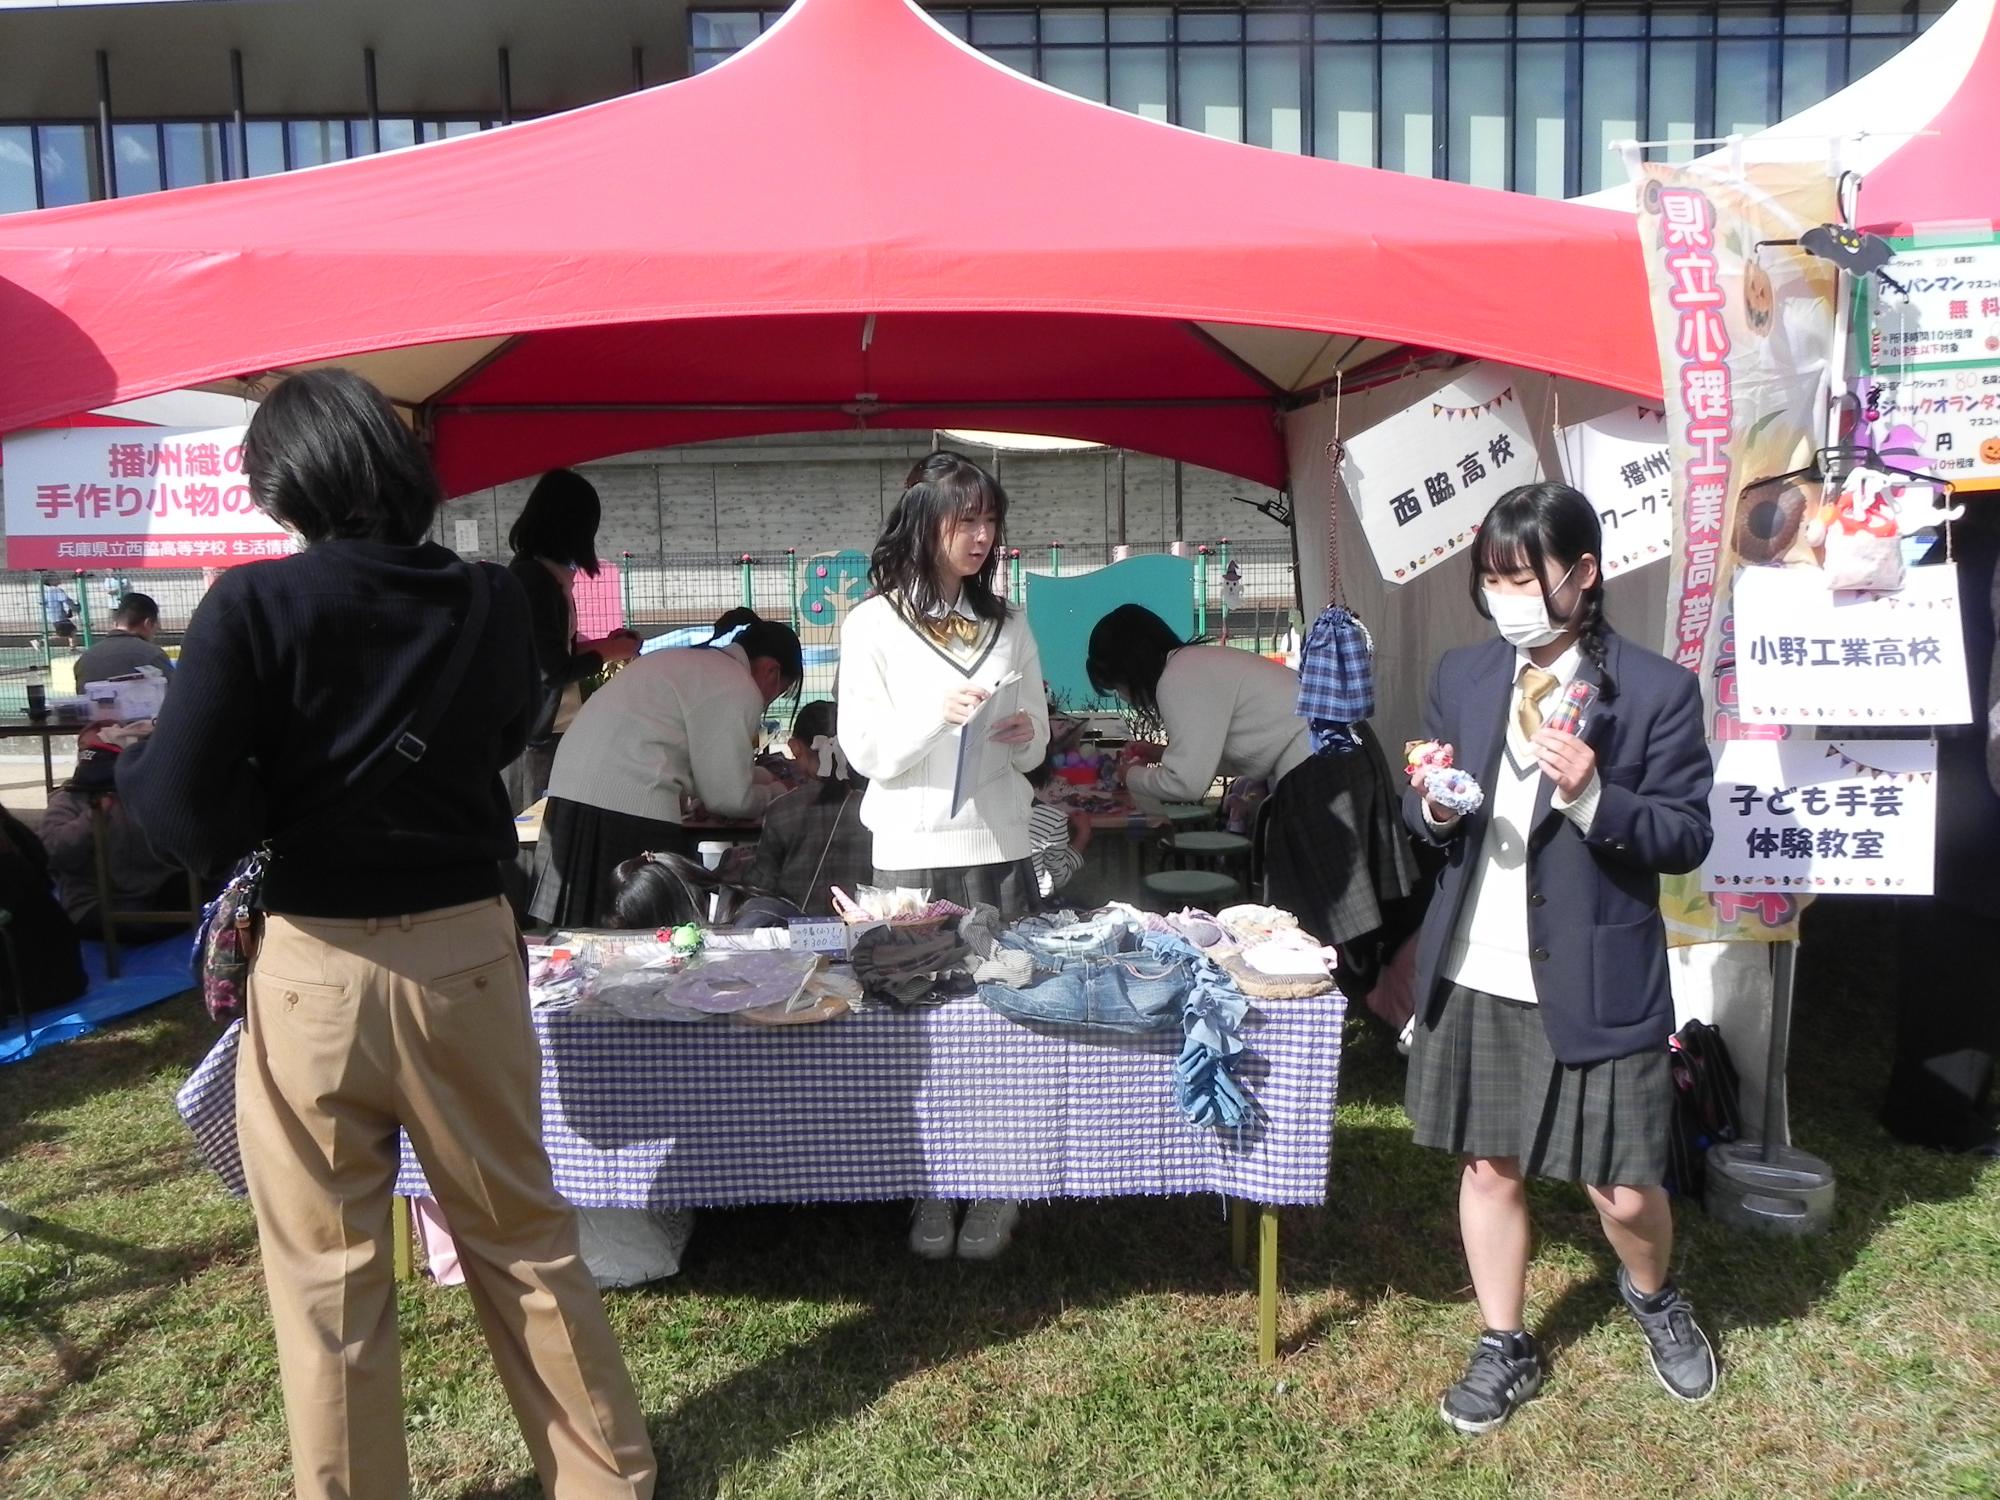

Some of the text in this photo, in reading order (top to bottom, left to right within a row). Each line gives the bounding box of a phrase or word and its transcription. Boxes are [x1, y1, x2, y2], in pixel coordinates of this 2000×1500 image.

[1936, 432, 1953, 451] 円
[1389, 433, 1516, 527] 西脇高校
[1620, 448, 1670, 489] 播州
[36, 483, 255, 518] 手作り小物の
[1751, 635, 1942, 667] 小野工業高校
[1730, 785, 1903, 816] 子ども手芸
[1747, 827, 1884, 860] 体験教室
